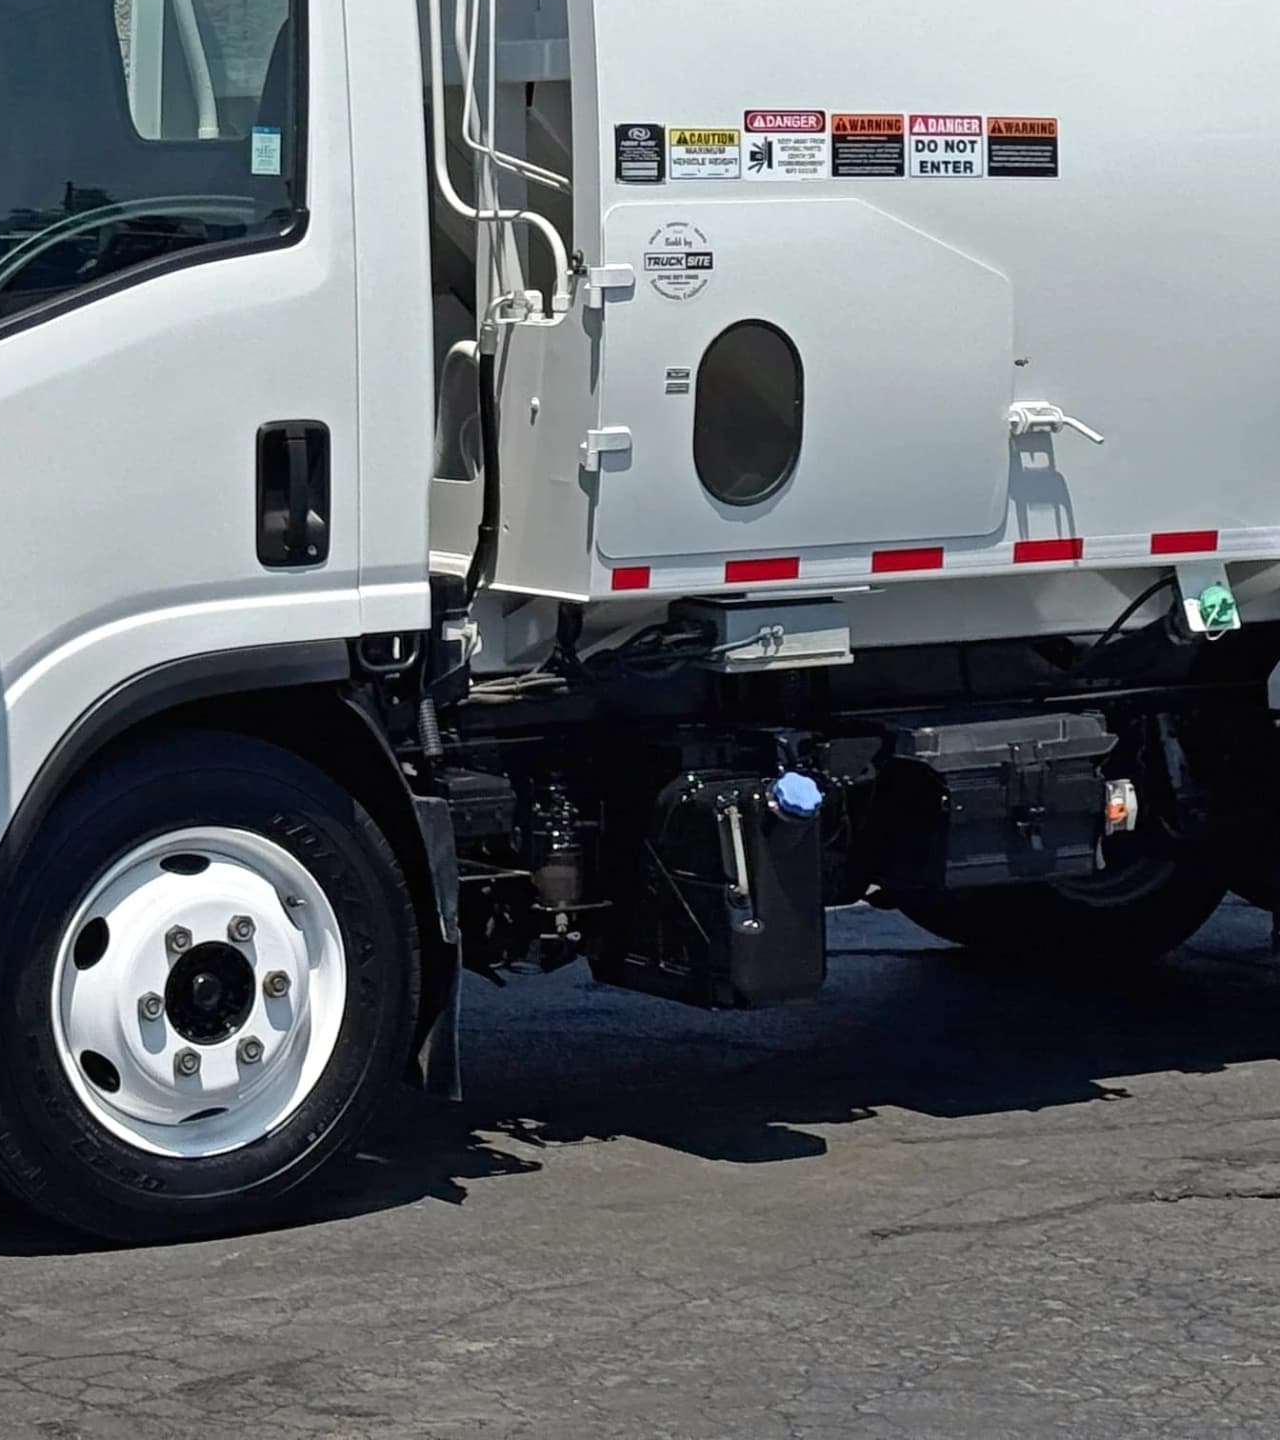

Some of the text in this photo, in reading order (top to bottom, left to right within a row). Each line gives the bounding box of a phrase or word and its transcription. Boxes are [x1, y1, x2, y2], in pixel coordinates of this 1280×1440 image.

[769, 115, 818, 128] DANGER
[849, 118, 902, 133] WARNING
[928, 118, 981, 134] DANGER
[1005, 120, 1055, 135] WARNING
[689, 132, 735, 145] CAUTION
[685, 147, 726, 155] MAXIMUM
[915, 139, 978, 154] DO NOT
[672, 157, 738, 166] VEHICLE HEIGHT
[920, 160, 974, 174] ENTER
[647, 256, 711, 267] TRUCK SITE
